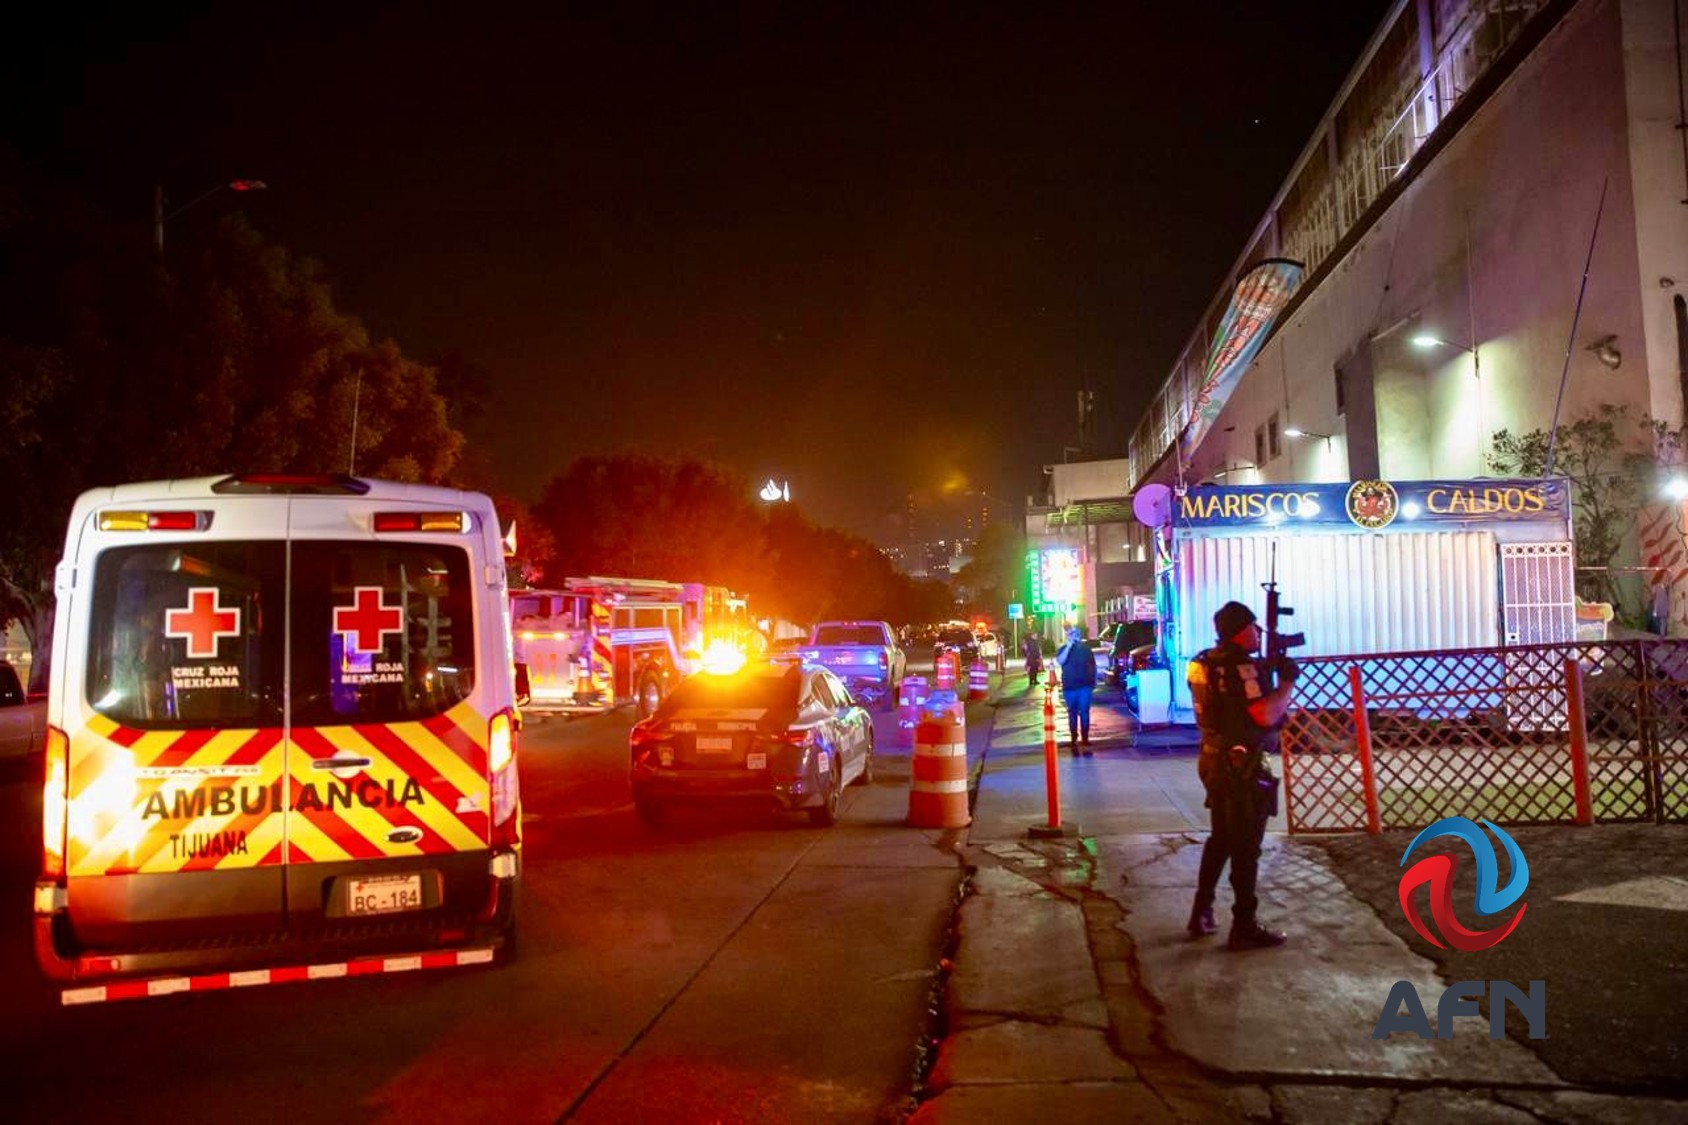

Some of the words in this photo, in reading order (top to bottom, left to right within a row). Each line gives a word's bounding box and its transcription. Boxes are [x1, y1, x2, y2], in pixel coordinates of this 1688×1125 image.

[1181, 492, 1319, 518] MARISCOS
[1427, 488, 1545, 514] CALDOS
[174, 667, 204, 677] CRUZ
[209, 666, 239, 676] ROJA
[375, 663, 404, 672] ROJA
[174, 678, 239, 688] MEXICANA
[141, 777, 425, 820] AMBULANCIA
[170, 831, 248, 859] TIJUANA
